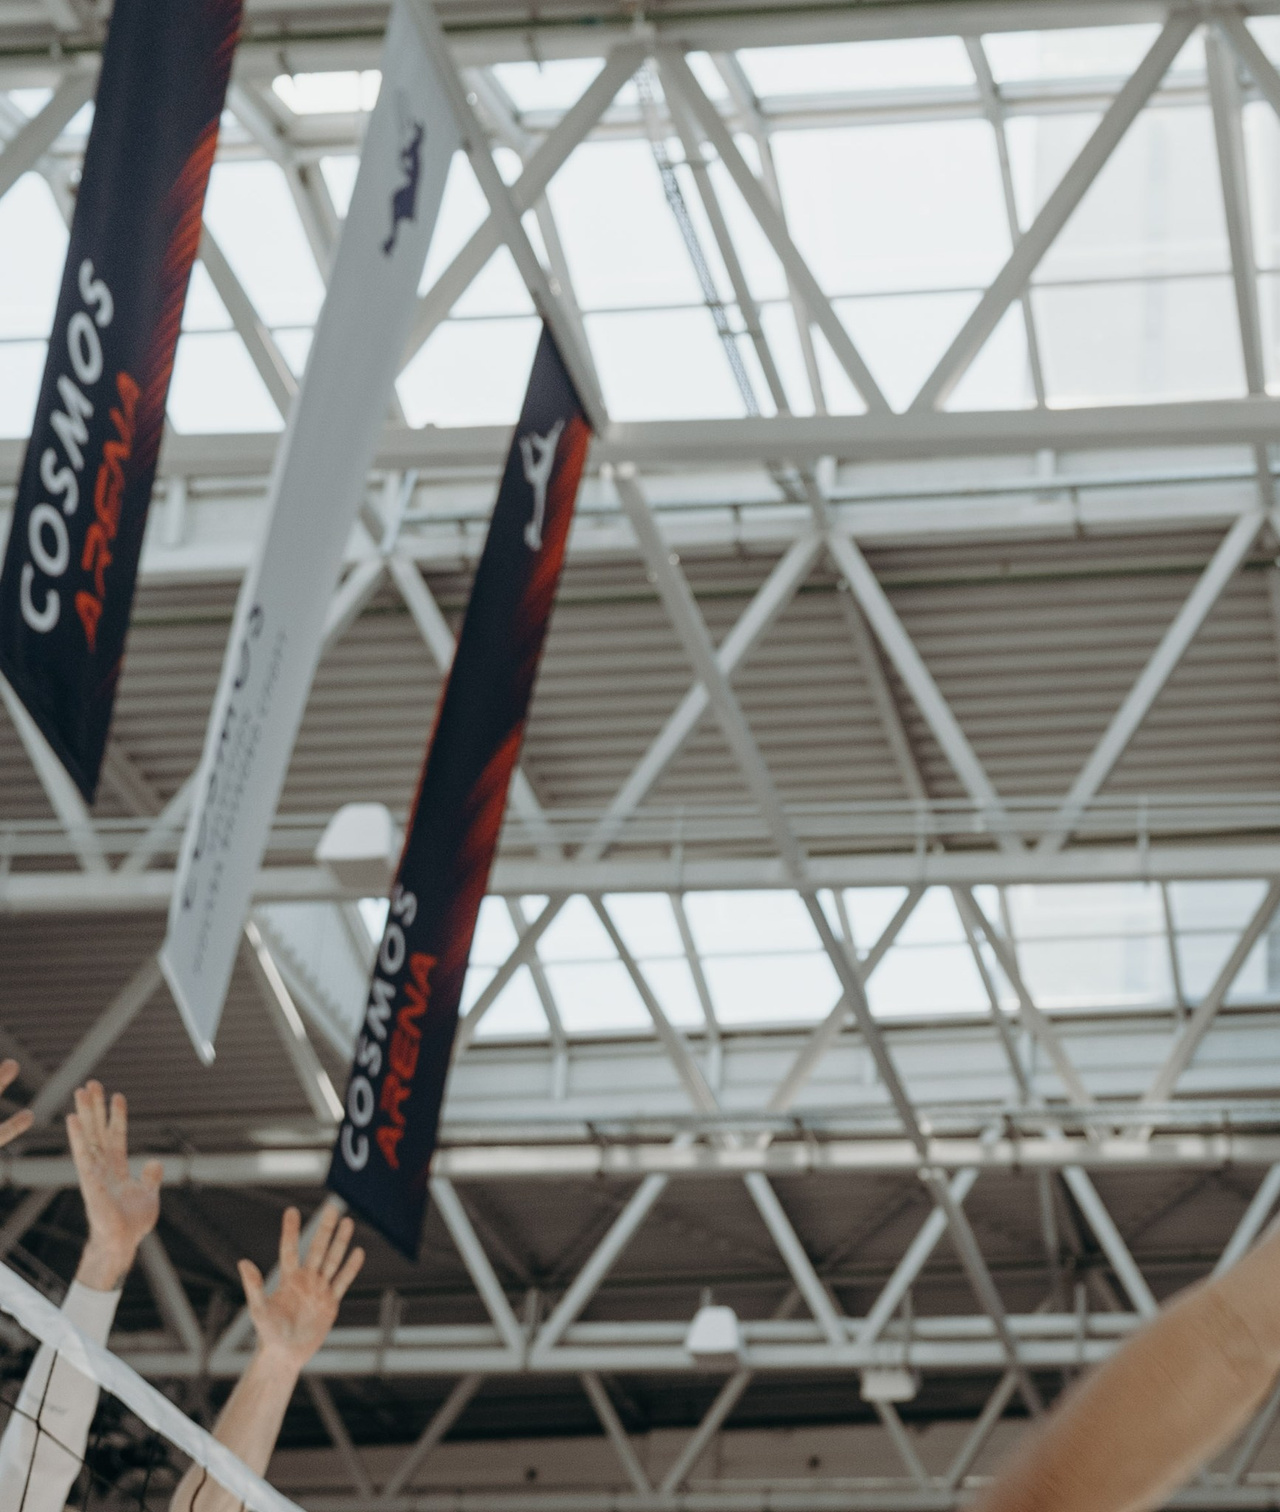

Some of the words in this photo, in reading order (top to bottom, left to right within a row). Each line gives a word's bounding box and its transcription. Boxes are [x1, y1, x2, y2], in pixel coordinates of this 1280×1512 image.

[20, 258, 114, 632] COSMOS
[75, 372, 139, 653] ARENA
[341, 884, 417, 1171] COSMOS
[376, 953, 437, 1169] ARENA
